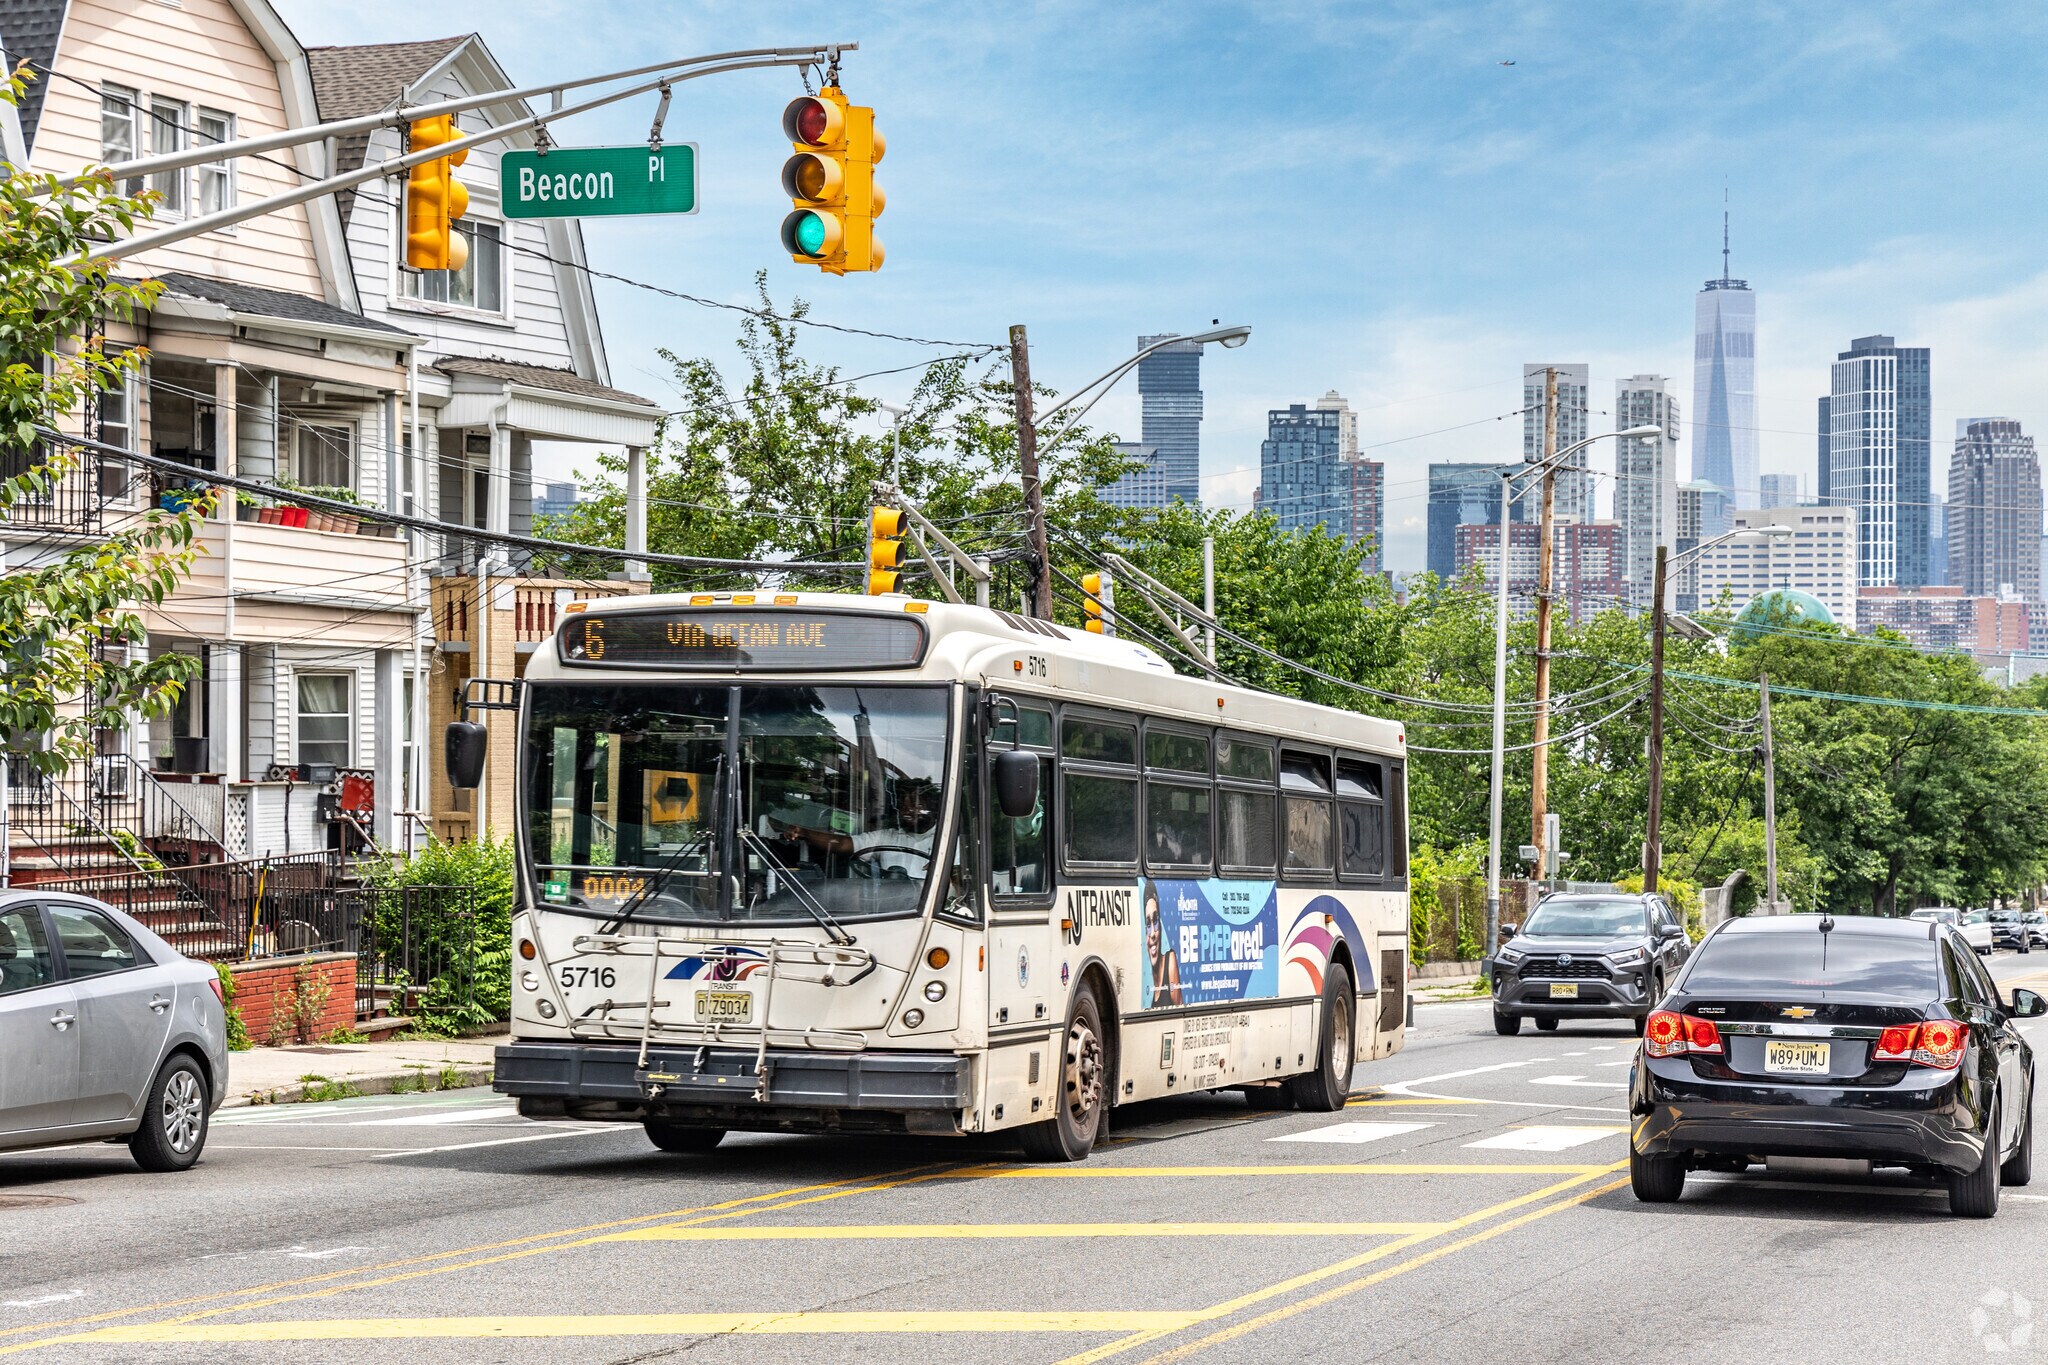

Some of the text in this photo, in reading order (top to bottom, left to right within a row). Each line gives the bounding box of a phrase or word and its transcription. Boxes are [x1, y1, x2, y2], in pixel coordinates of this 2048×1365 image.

[519, 156, 665, 202] Beacon Pl
[585, 620, 605, 660] 6
[667, 623, 826, 647] VIA OCEAN AVE
[1029, 655, 1047, 678] 5716
[1082, 889, 1132, 927] TRANSIT
[1180, 921, 1264, 963] BE PrEPared!
[561, 966, 616, 988] 5716
[711, 982, 738, 990] TRANSIT
[1770, 1049, 1826, 1066] W89 UMJ
[1796, 1043, 1814, 1051] Jersey
